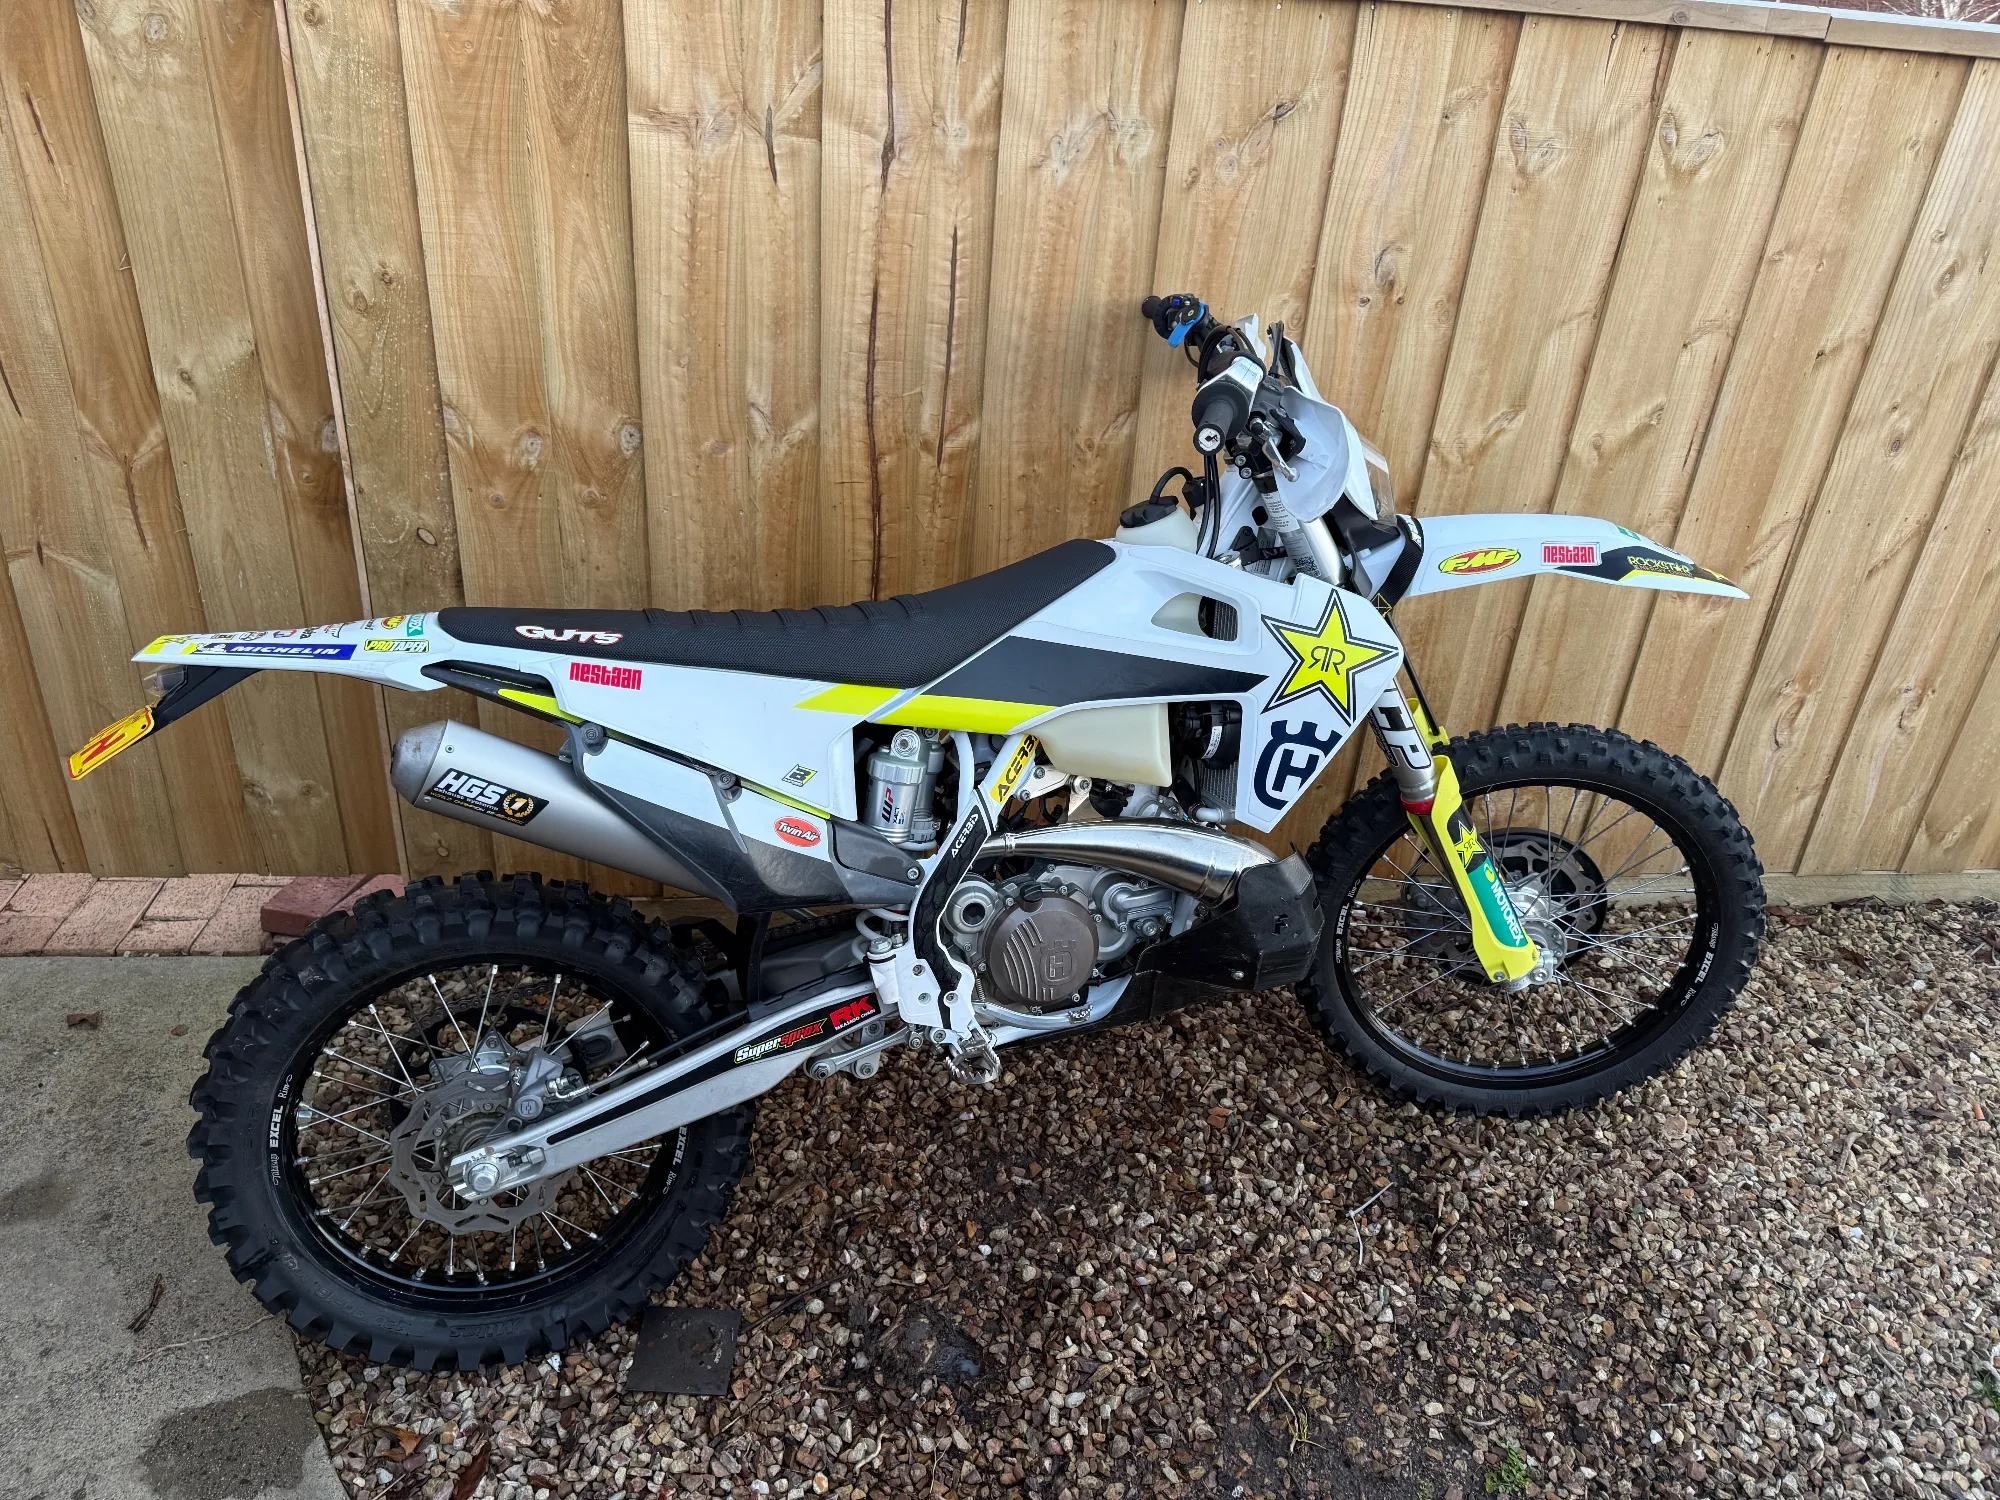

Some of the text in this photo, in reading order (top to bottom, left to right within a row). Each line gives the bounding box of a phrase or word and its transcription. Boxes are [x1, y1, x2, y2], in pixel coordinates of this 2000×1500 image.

[1441, 549, 1519, 573] FMF
[1543, 545, 1595, 564] nestaan
[230, 645, 341, 655] MICHELIN
[514, 625, 624, 646] GUTS
[569, 661, 643, 691] nestaan
[436, 770, 508, 805] HGS
[777, 819, 820, 843] Twin Air
[1335, 902, 1350, 935] EXCEL
[1490, 880, 1525, 947] MOTOREX
[1694, 951, 1715, 984] EXCEL
[829, 996, 873, 1028] RK
[269, 1105, 284, 1148] EXCEL
[672, 1125, 688, 1166] EXCEL
